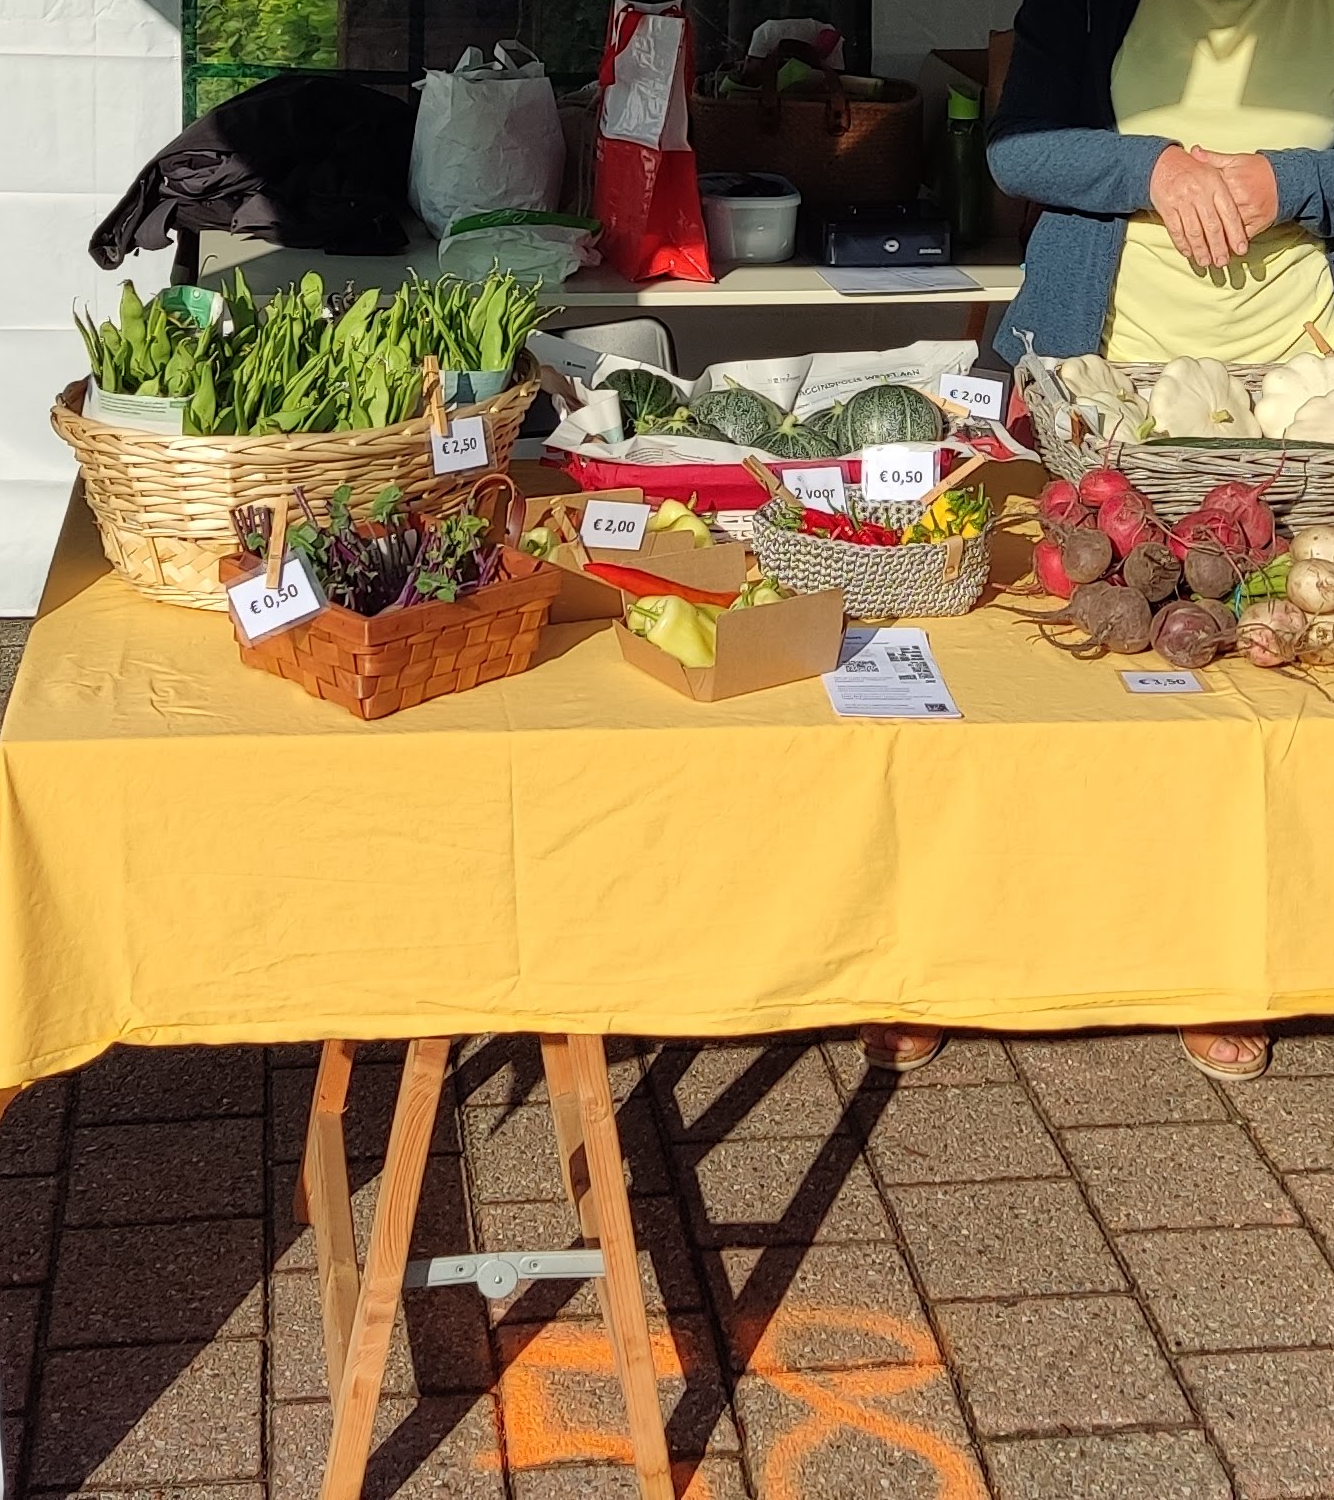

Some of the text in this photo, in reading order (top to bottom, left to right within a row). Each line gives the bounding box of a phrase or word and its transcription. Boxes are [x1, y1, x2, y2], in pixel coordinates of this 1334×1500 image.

[949, 387, 991, 407] € 2,00
[441, 437, 478, 457] € 2,50
[879, 470, 923, 485] € 0,50
[794, 487, 836, 499] 2 voor
[592, 518, 636, 535] € 2,00
[249, 582, 299, 615] € 0,50
